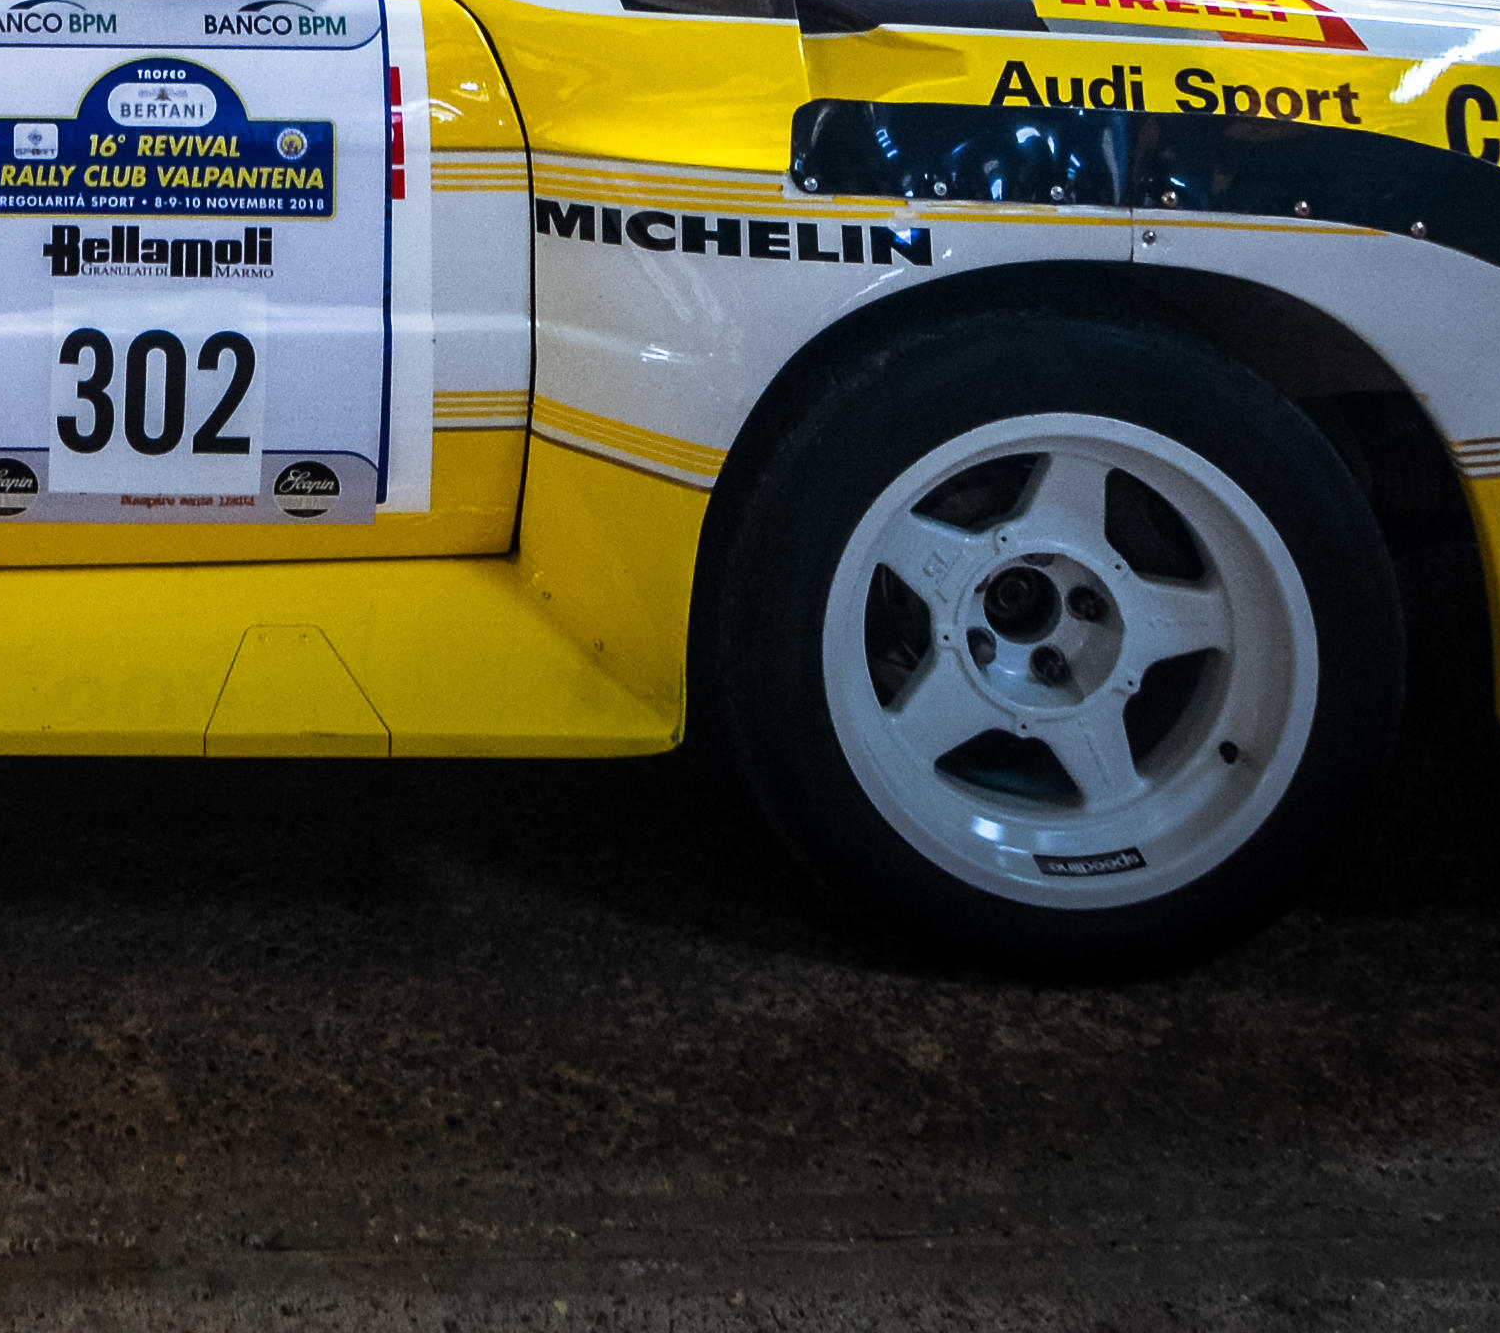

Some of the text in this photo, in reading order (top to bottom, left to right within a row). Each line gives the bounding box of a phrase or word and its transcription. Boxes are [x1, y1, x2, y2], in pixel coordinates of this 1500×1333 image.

[69, 13, 117, 35] BPM
[204, 14, 347, 36] BANCO BPM
[137, 69, 187, 80] TROFEO
[992, 60, 1362, 124] Audi Sport
[120, 102, 205, 119] BERTANI
[89, 134, 240, 157] 16° REVIVAL
[0, 164, 325, 189] RALLY CLUB VALPANTENA
[0, 192, 325, 211] REGOLARITÀ SPORT 8-9-10 NOVEMBRE 2018
[535, 198, 933, 266] MICHELIN
[43, 224, 273, 278] Bellamoli
[80, 263, 152, 278] GRANULATI
[215, 265, 274, 278] MARMO
[56, 328, 257, 455] 302
